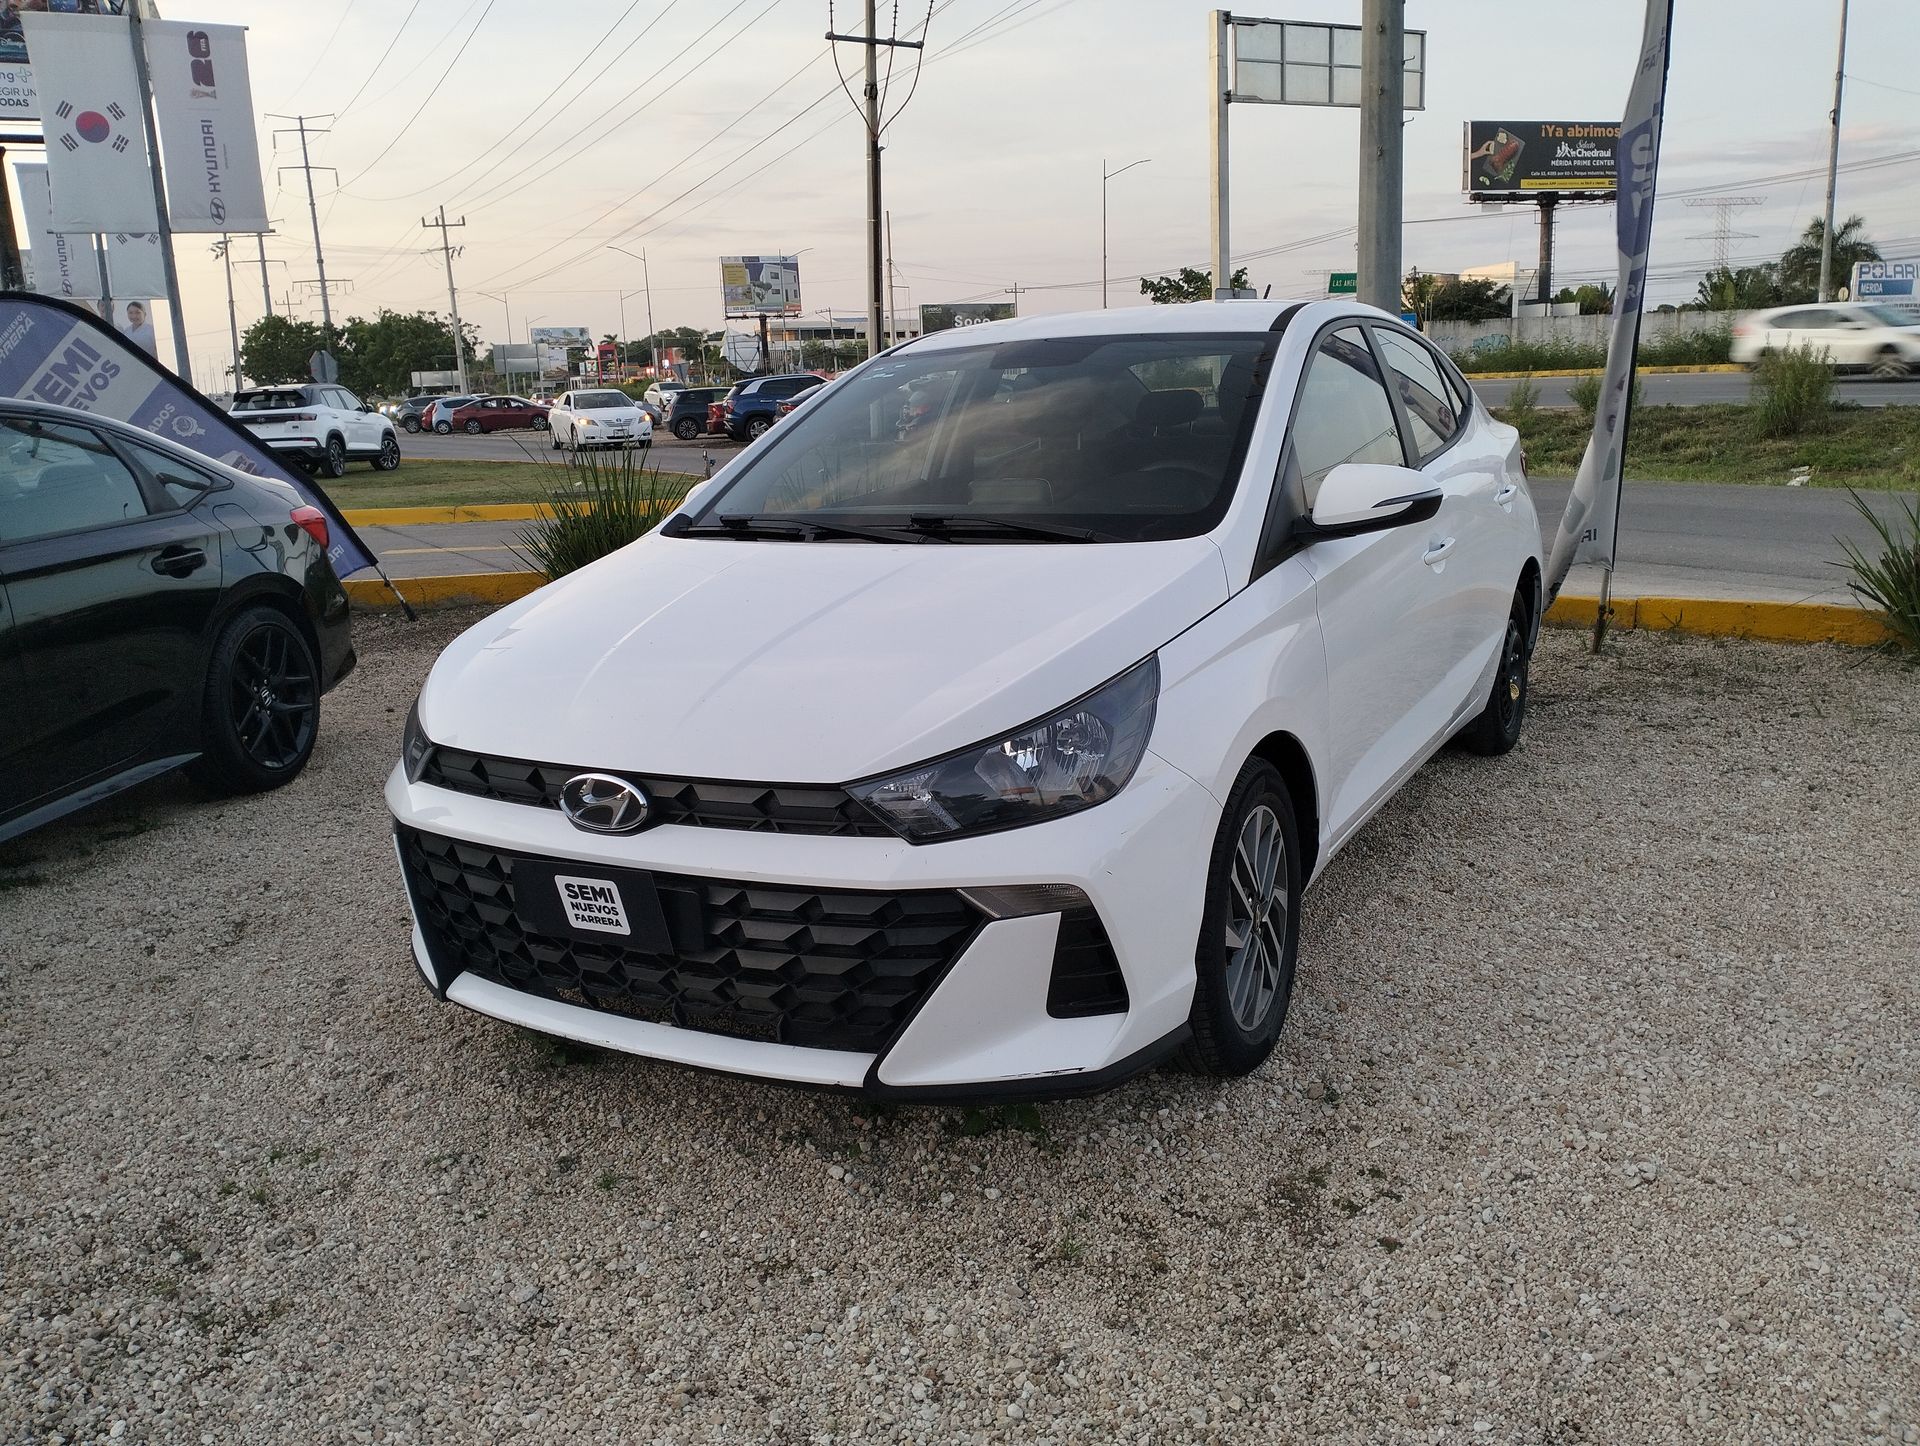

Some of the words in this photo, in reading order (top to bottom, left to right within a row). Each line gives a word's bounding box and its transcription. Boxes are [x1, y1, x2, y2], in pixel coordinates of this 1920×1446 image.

[1567, 124, 1621, 137] abrimos
[200, 119, 222, 193] HYUNDAI
[1576, 148, 1612, 157] Chedraui
[56, 233, 69, 277] HYUNDA
[24, 337, 103, 406] EMI
[66, 359, 121, 411] EVOS
[564, 882, 617, 905] SEMI
[570, 901, 620, 916] NUEVOS
[574, 913, 623, 928] FARRERA
